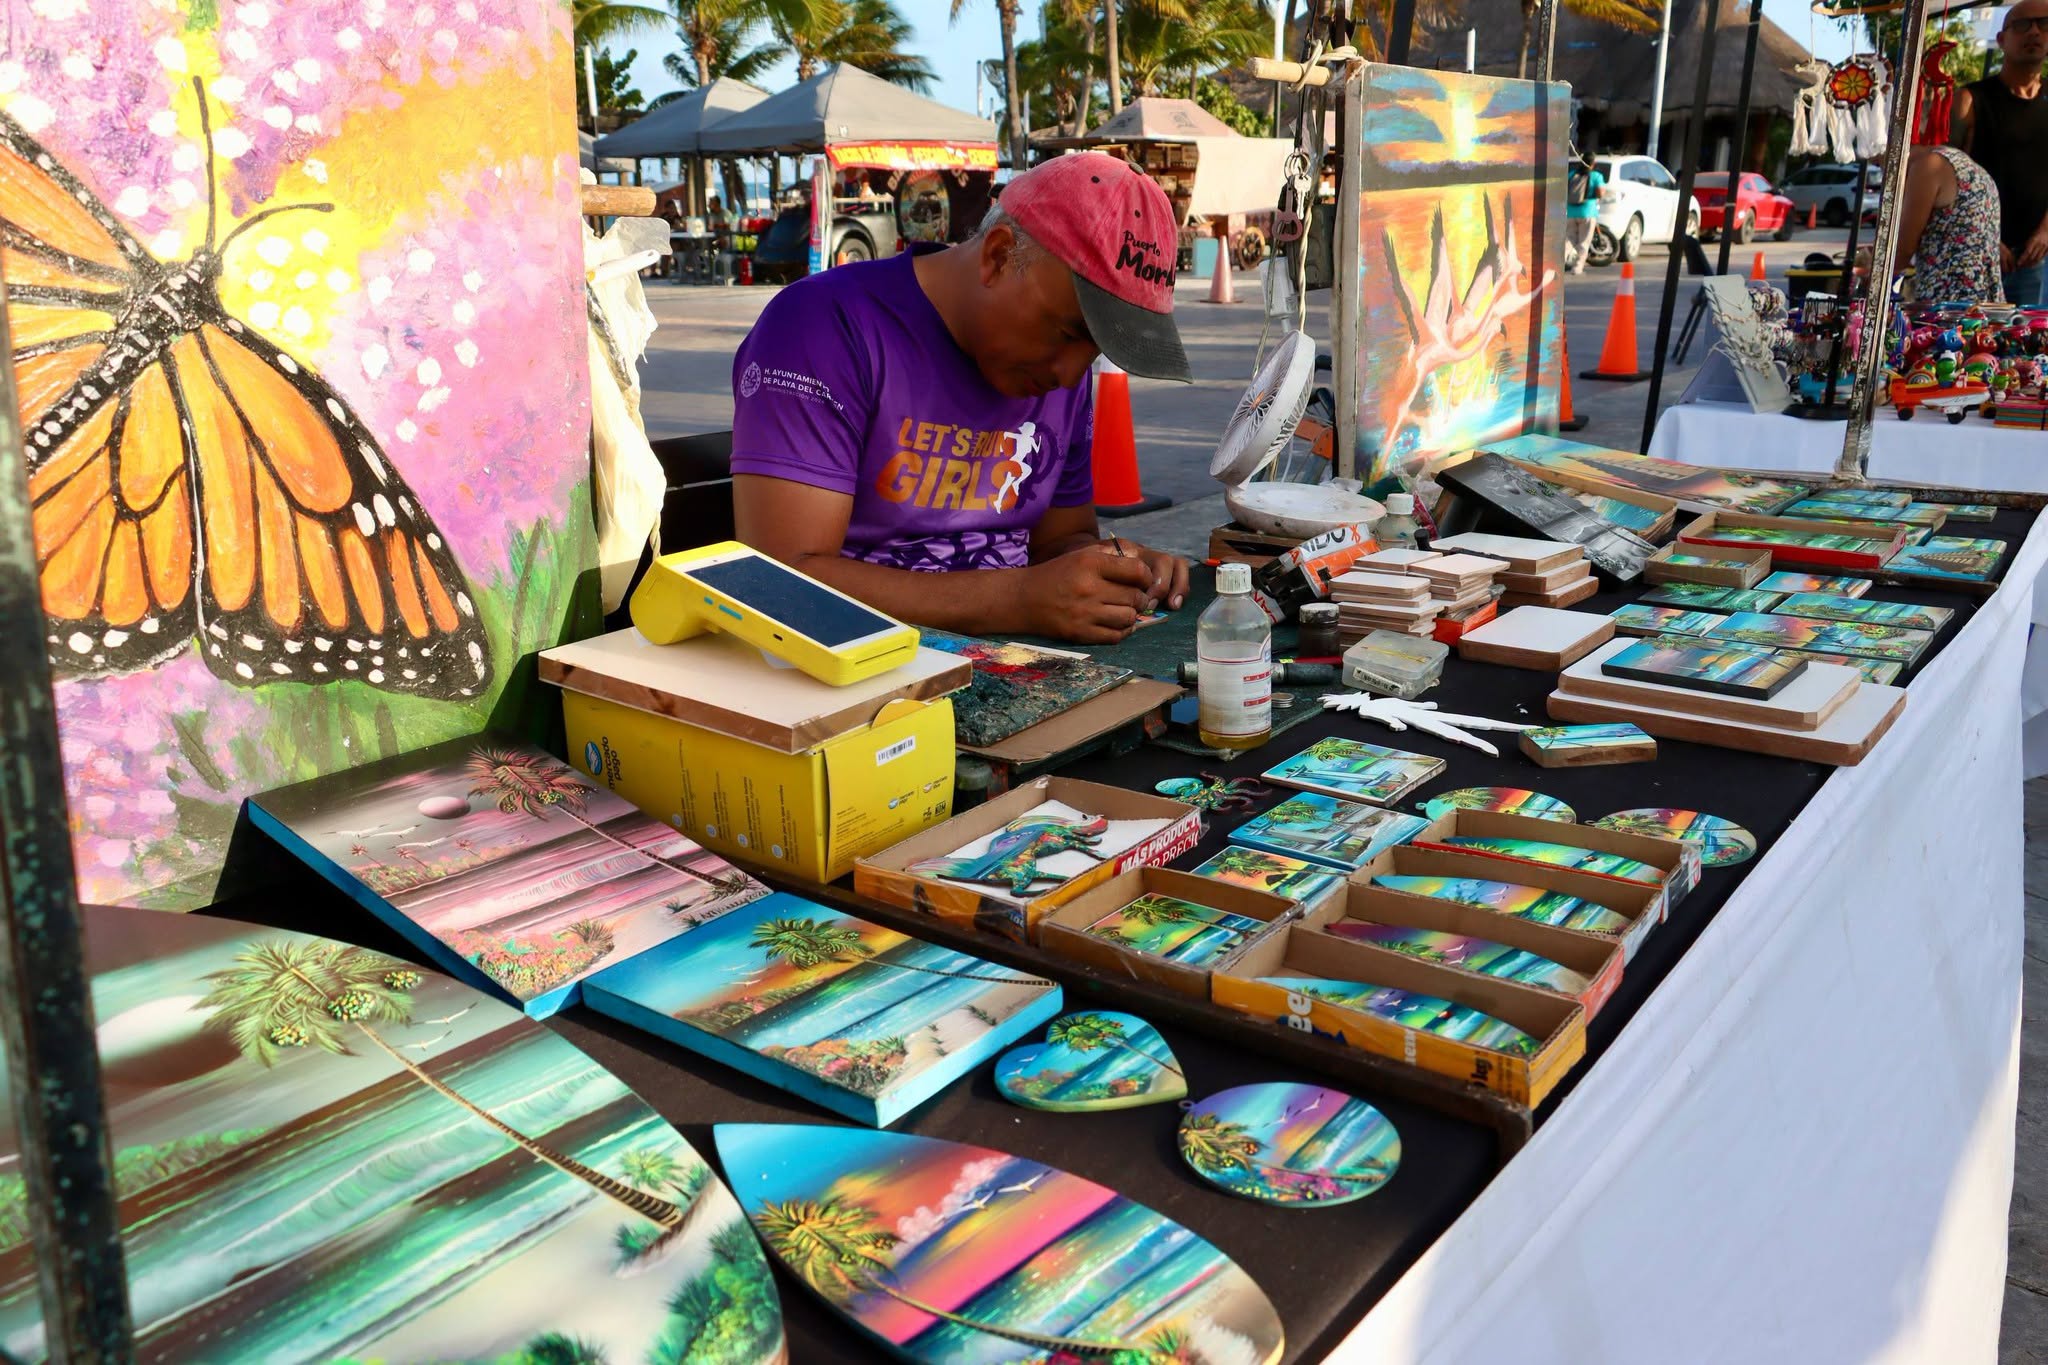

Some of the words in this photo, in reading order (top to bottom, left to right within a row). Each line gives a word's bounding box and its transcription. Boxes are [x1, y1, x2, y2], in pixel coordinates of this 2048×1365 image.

[1123, 230, 1161, 257] Puerto
[773, 378, 796, 389] PLAYA
[797, 384, 814, 394] DEL
[898, 417, 973, 457] LET'S
[877, 451, 1023, 511] GIRLS
[602, 736, 615, 790] mercado
[611, 750, 622, 781] pago
[1121, 846, 1148, 875] MÁS
